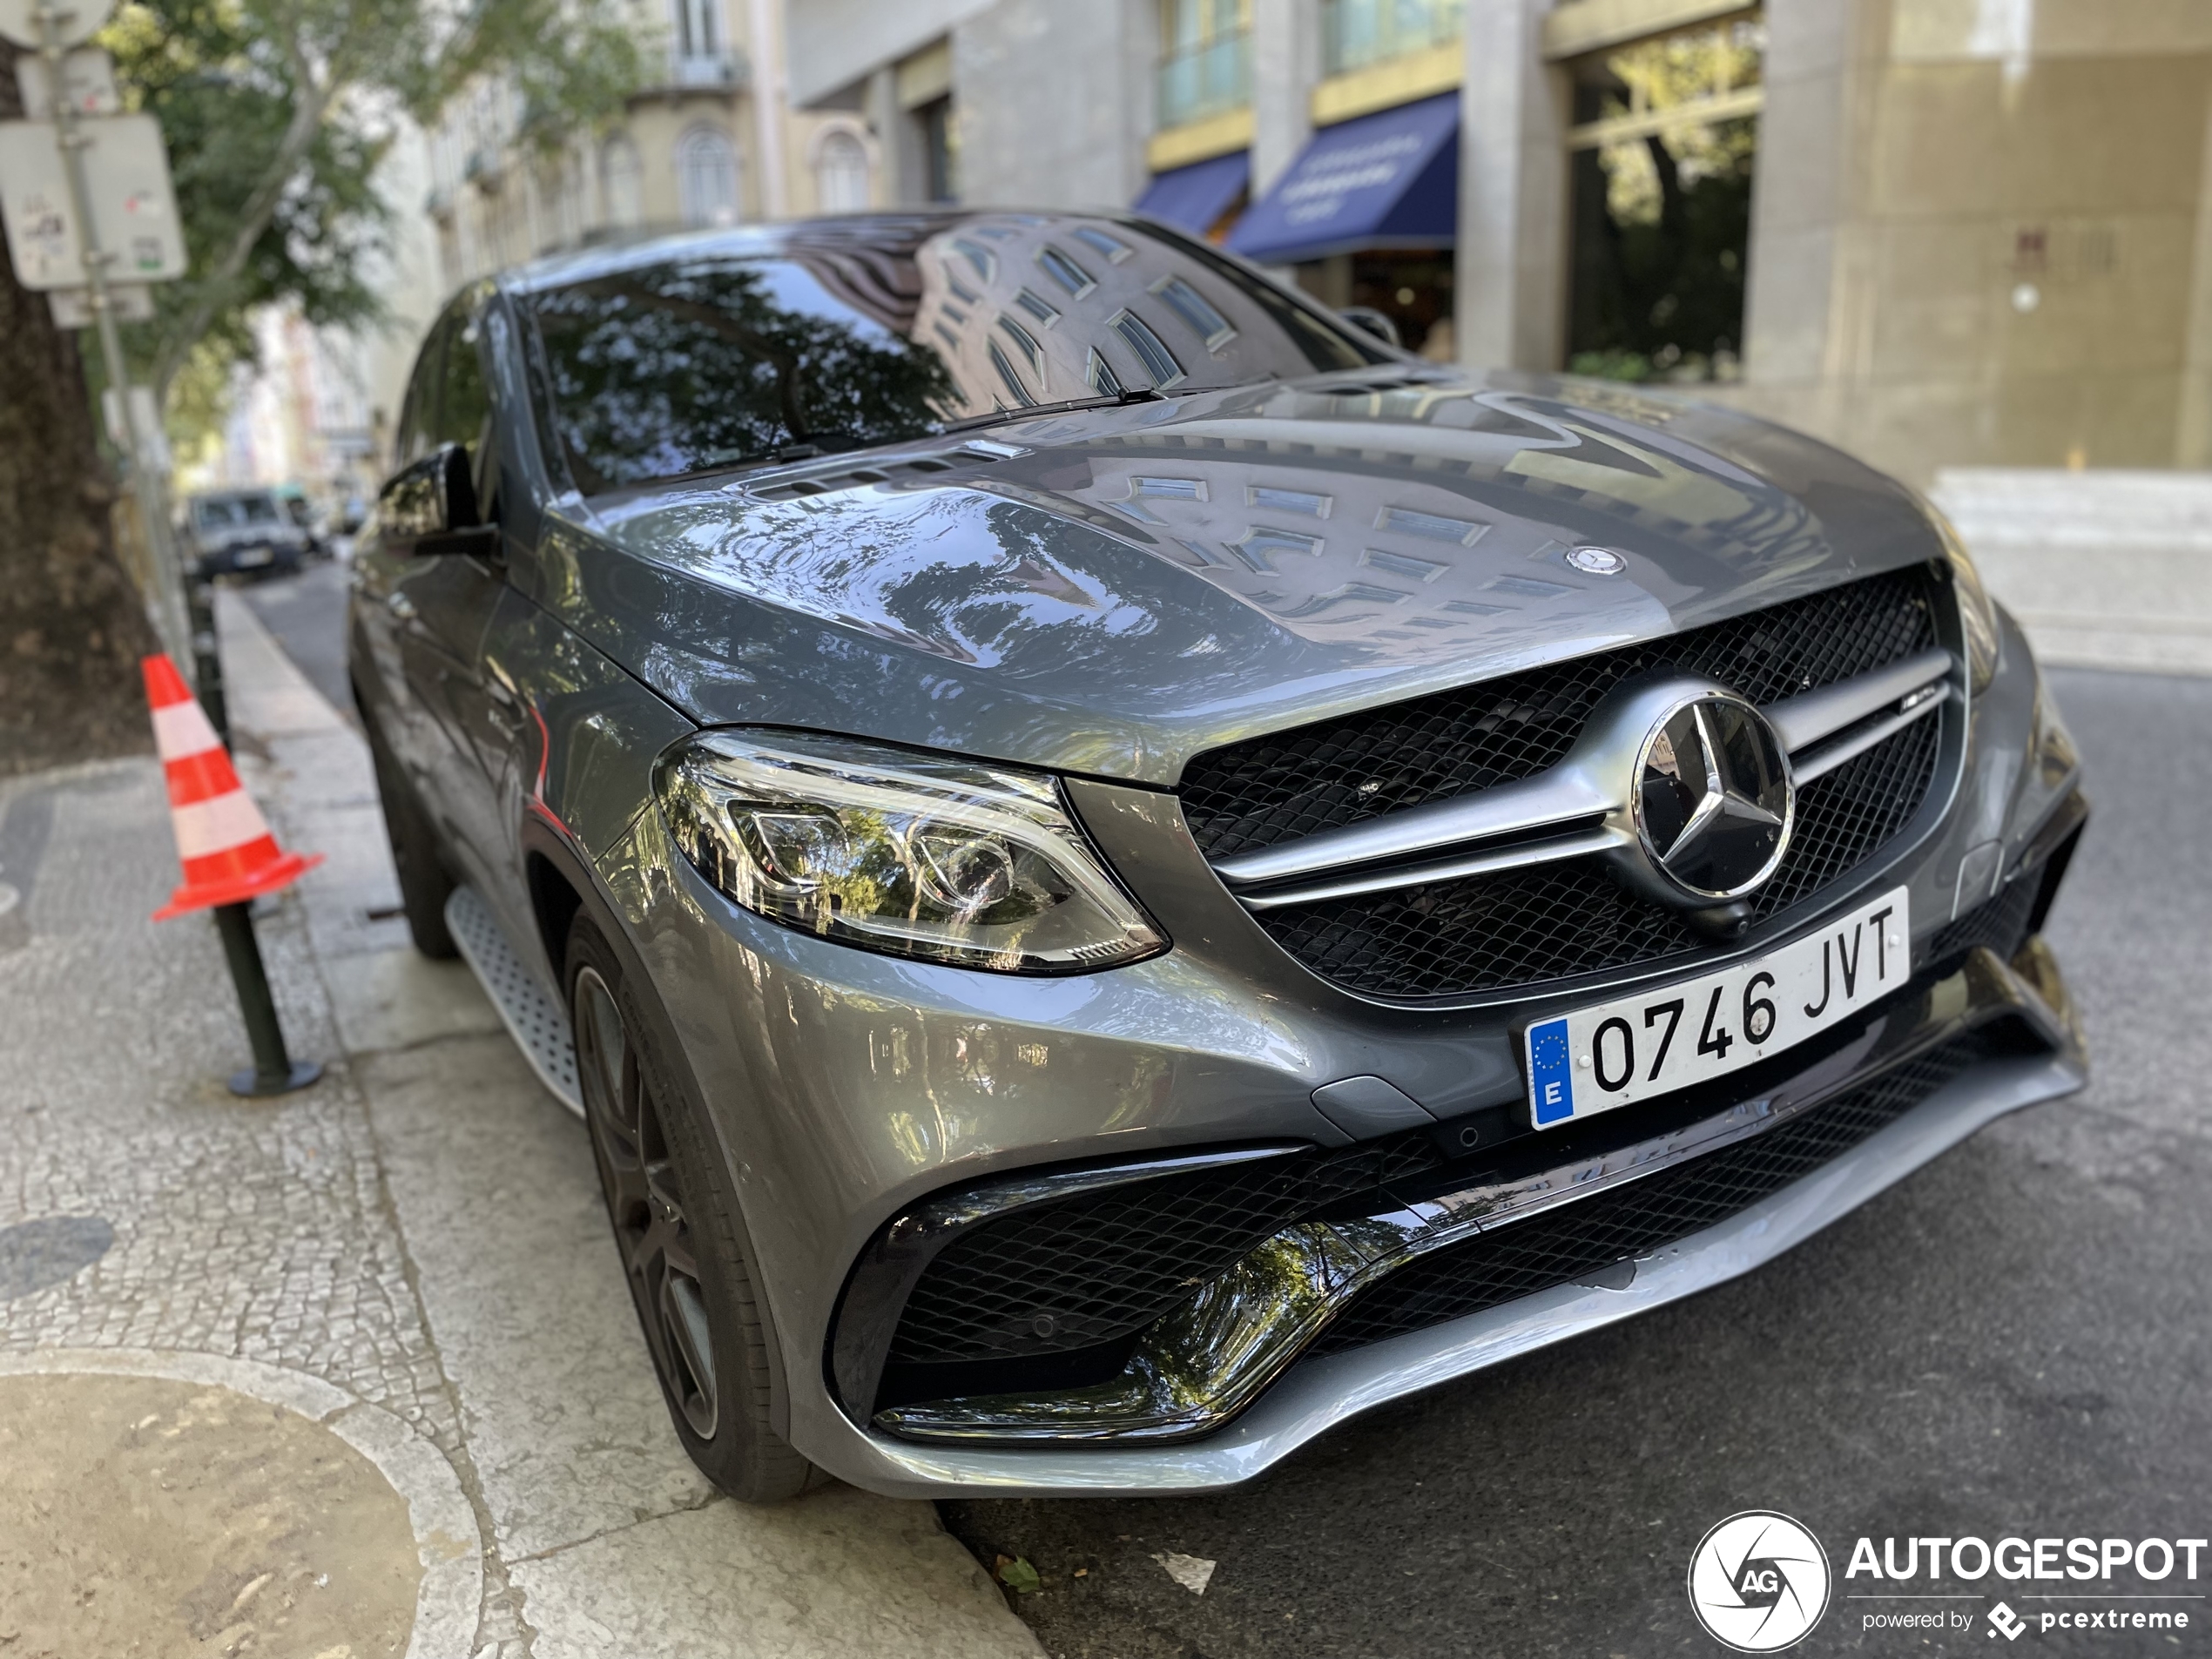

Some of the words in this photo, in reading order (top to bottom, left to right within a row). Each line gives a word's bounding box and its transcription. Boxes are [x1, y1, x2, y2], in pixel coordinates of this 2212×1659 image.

[1592, 972, 1776, 1092] 0746
[1804, 906, 1893, 1018] JVT
[1545, 1081, 1562, 1105] E
